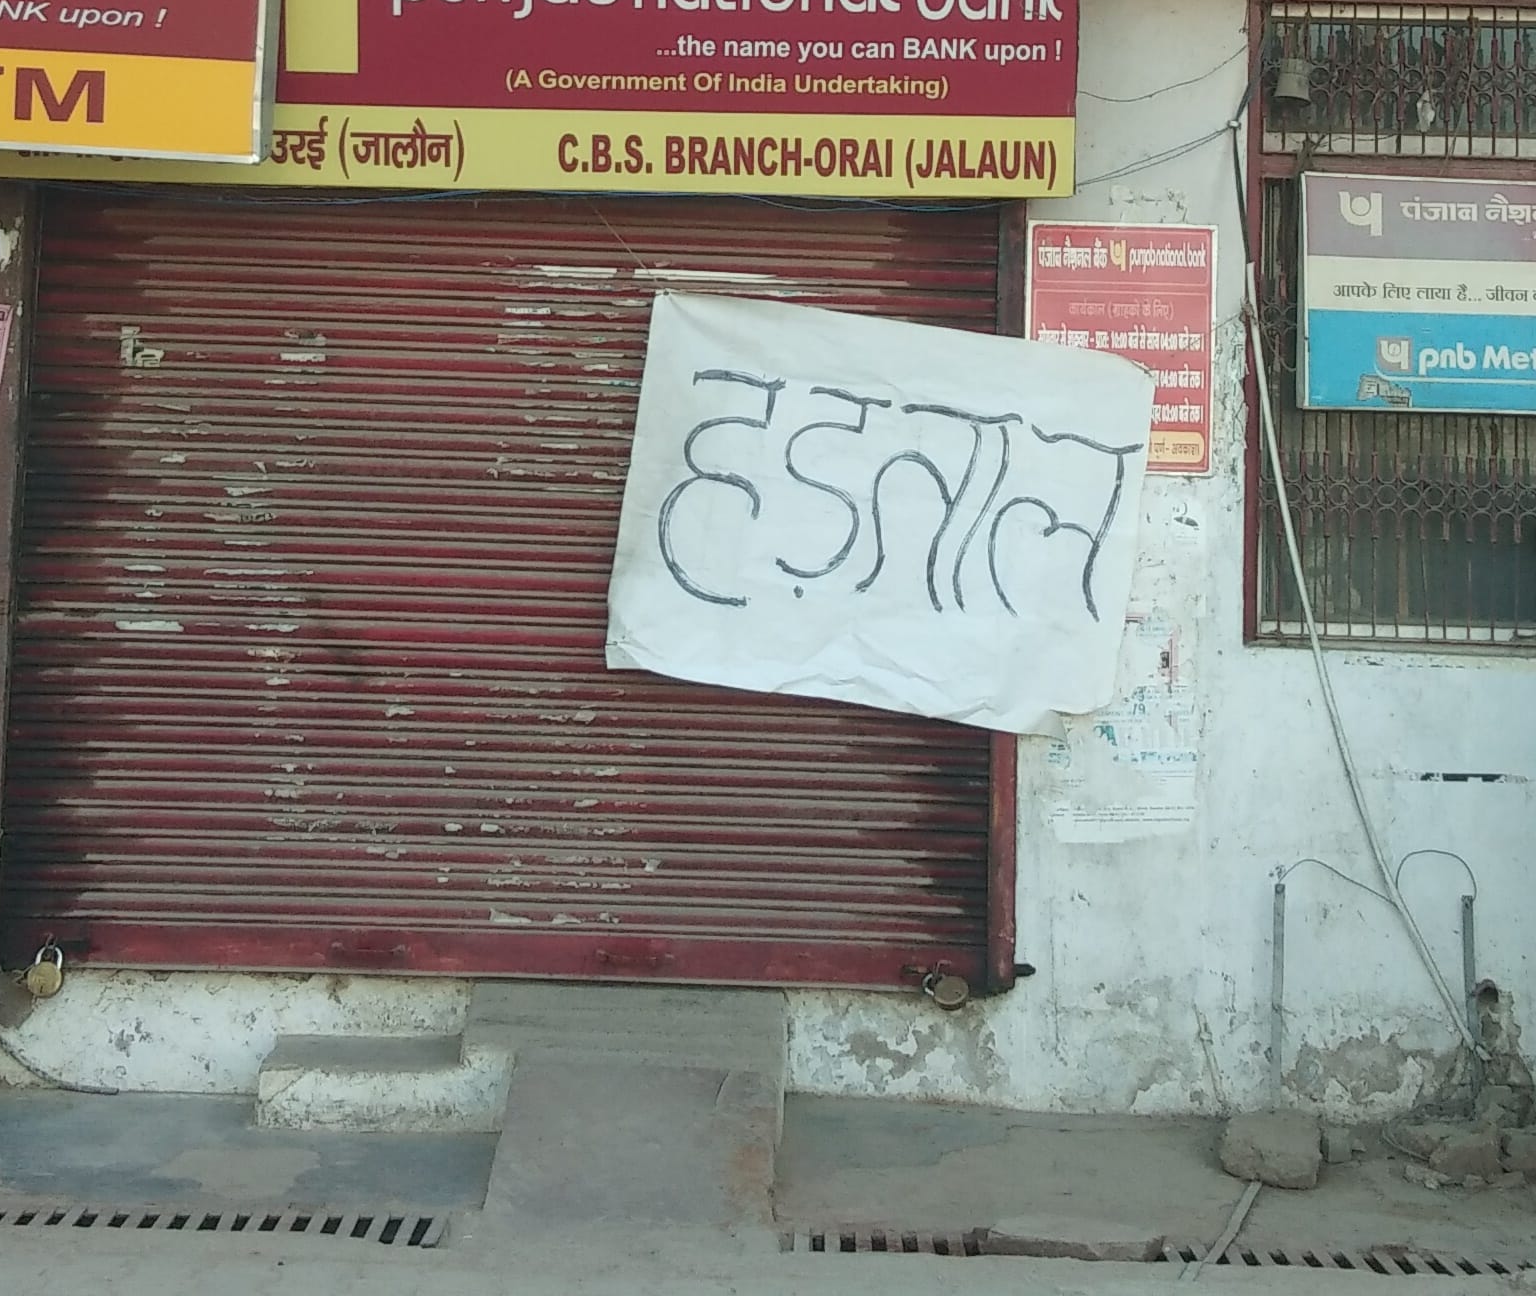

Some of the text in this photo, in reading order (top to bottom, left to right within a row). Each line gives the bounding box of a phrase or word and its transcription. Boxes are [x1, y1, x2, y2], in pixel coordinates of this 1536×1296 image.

[58, 4, 143, 30] upon
[724, 38, 1047, 66] name you can BANK upon
[505, 69, 949, 100] (A Government Of India Undertaking)
[270, 116, 465, 182] उरई (जालौन)
[558, 133, 1057, 190] C.B.S. BRANCH-ORAI (JALAUN)
[1400, 197, 1479, 222] पंजाब
[1188, 243, 1207, 267] bank
[1333, 281, 1377, 299] आपके
[1382, 283, 1410, 300] लिए
[1416, 287, 1451, 301] लाया
[1485, 286, 1529, 303] जीवन
[1418, 342, 1476, 375] pnb
[658, 370, 1144, 622] हड़ताल
